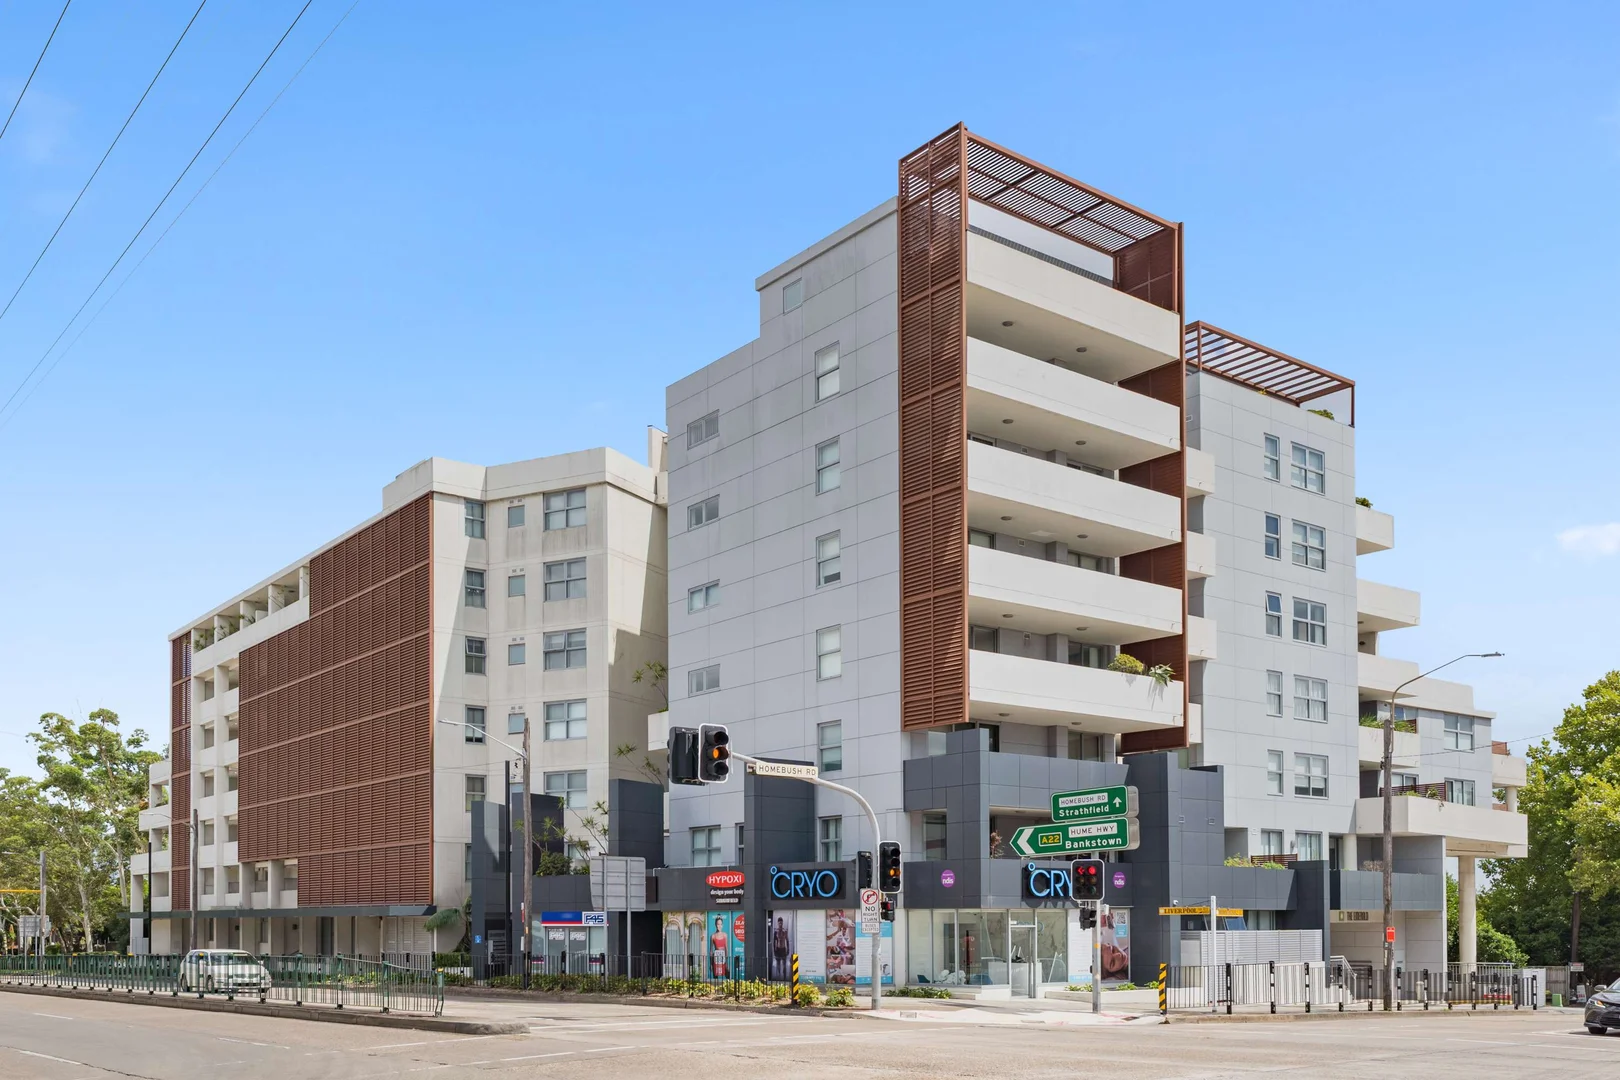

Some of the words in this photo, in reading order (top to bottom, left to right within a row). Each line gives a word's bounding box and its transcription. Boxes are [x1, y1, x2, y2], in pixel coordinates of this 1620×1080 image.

[759, 765, 802, 775] HOMEBUSH
[806, 768, 816, 776] RD
[1060, 796, 1094, 805] HOMEBUSH
[1059, 805, 1109, 817] Strathfield
[1070, 827, 1093, 835] HUME
[1096, 825, 1115, 833] HWY
[1041, 835, 1060, 844] A22
[1065, 838, 1122, 849] Bankstown
[708, 875, 742, 884] HYPOXI
